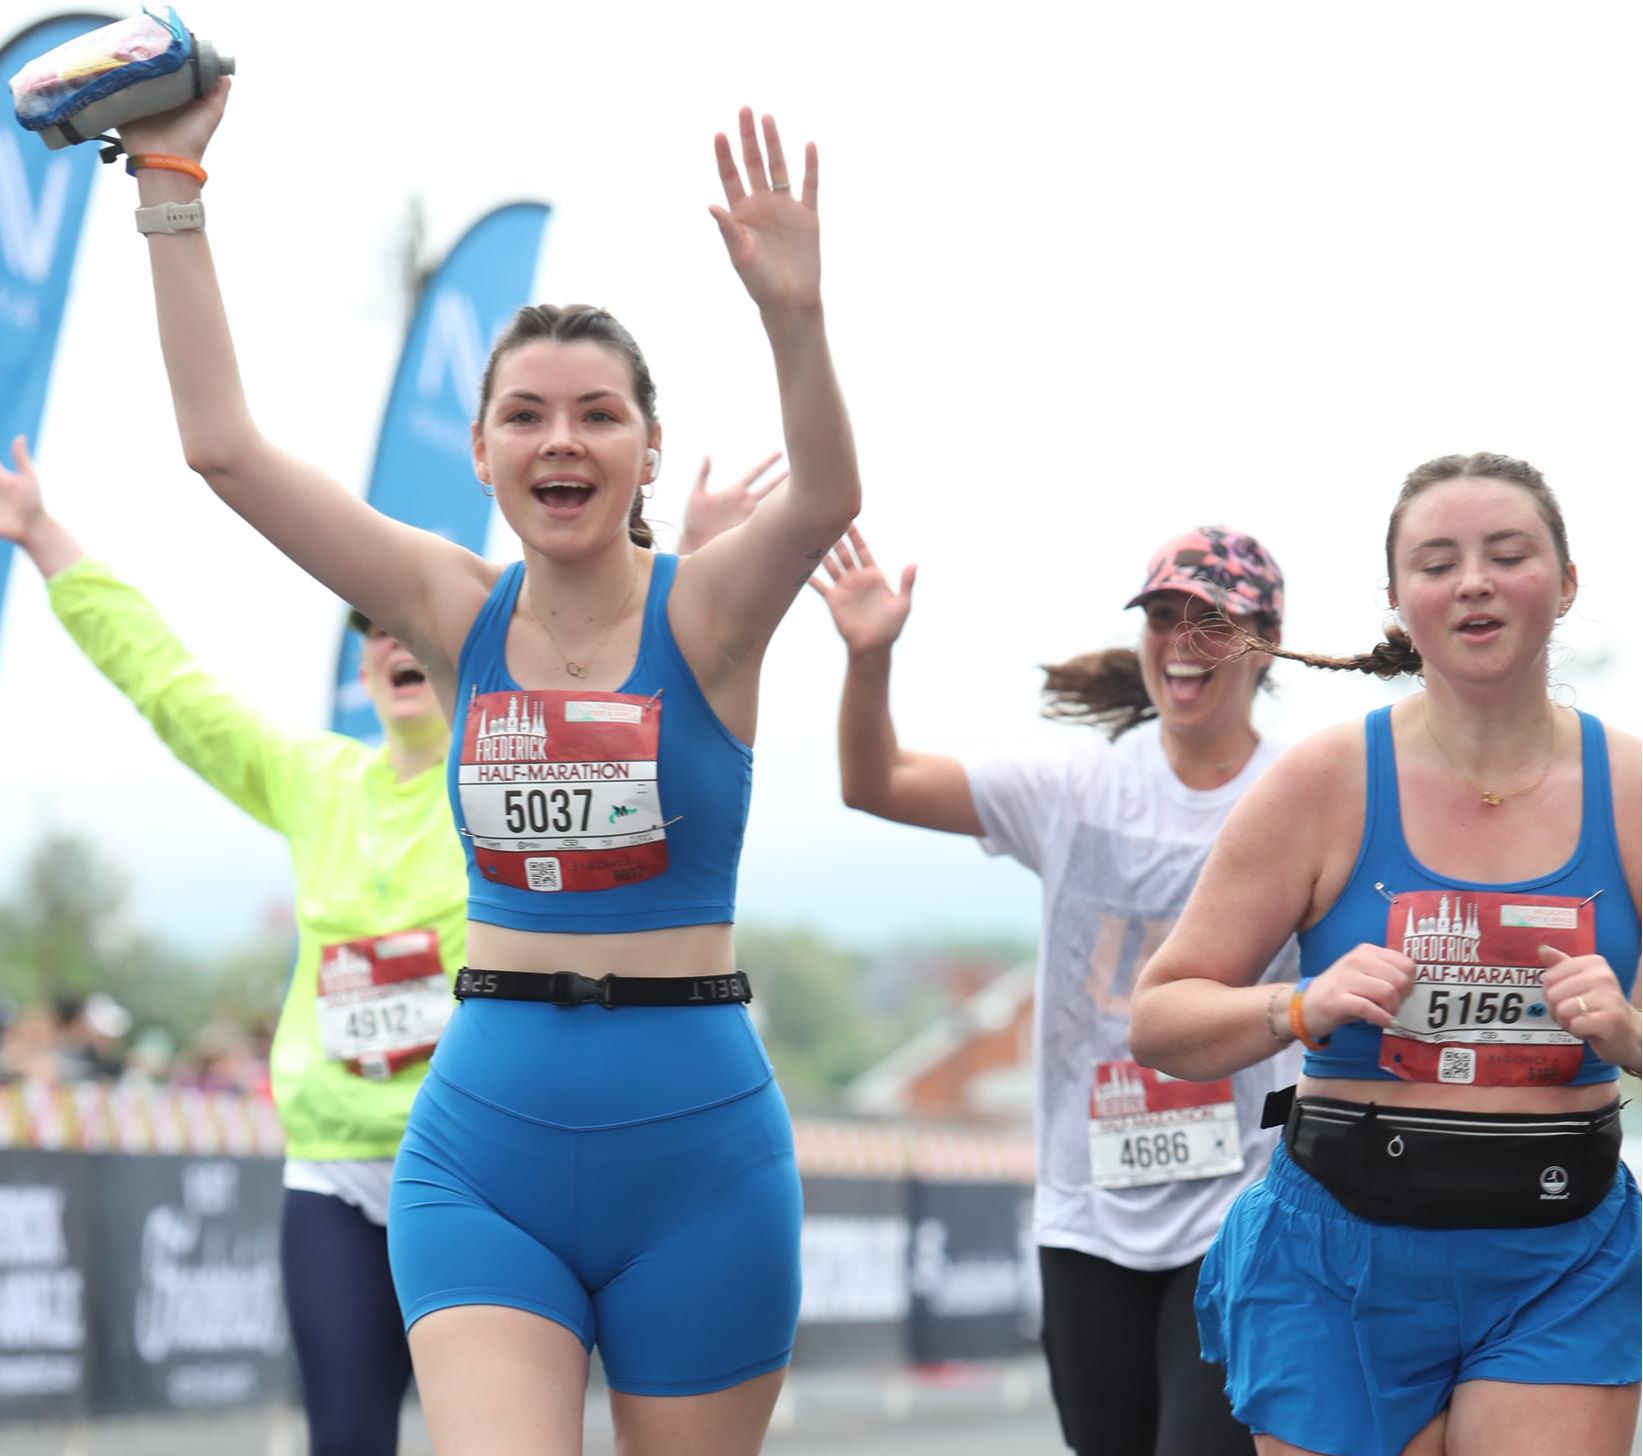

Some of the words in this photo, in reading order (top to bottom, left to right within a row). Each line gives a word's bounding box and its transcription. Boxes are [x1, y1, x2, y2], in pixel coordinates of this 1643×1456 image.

[475, 735, 548, 762] FREDERICK
[478, 763, 630, 782] HALF-MARATHON
[504, 788, 593, 834] 5037
[1403, 935, 1481, 963] FREDERICK
[344, 1003, 409, 1038] 4912
[1427, 990, 1525, 1030] 5156
[1120, 1131, 1190, 1169] 4686
